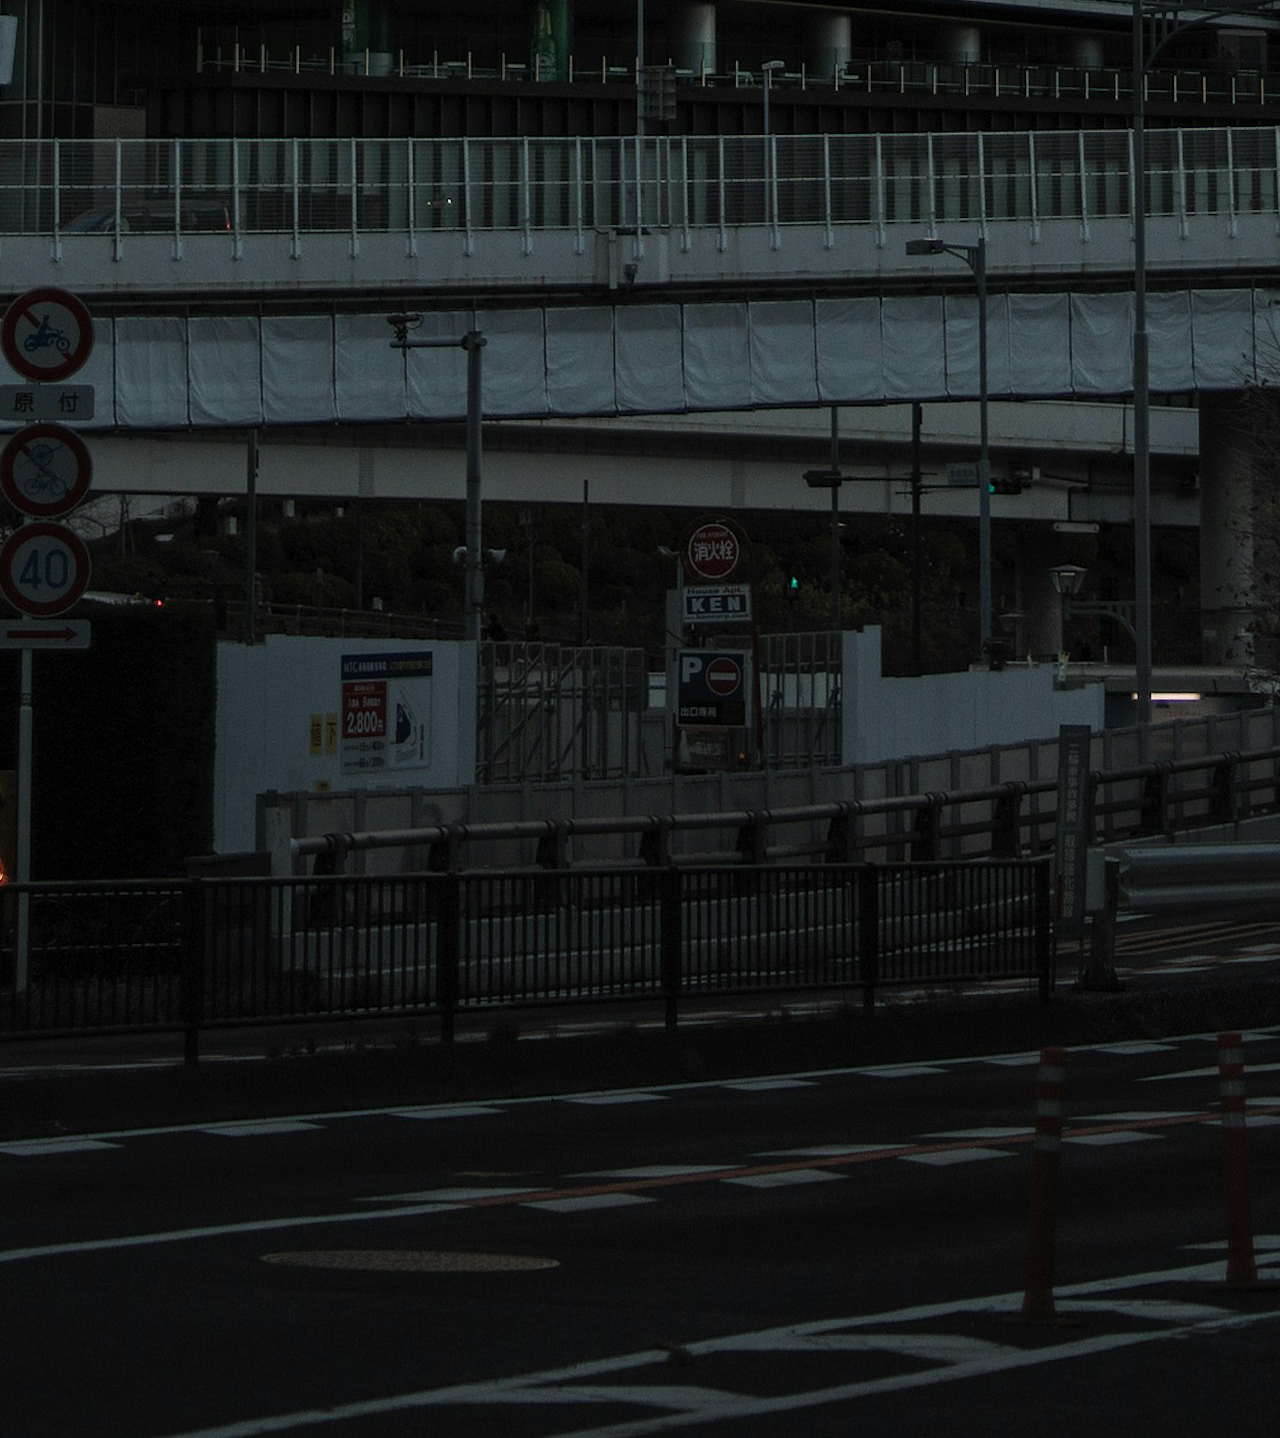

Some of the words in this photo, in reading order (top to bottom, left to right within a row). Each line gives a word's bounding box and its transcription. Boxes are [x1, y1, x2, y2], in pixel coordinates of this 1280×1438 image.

[13, 391, 80, 414] 原付
[693, 539, 735, 563] 消火栓
[19, 548, 70, 590] 40
[687, 587, 720, 595] House
[691, 596, 741, 613] KEN
[681, 656, 703, 683] P
